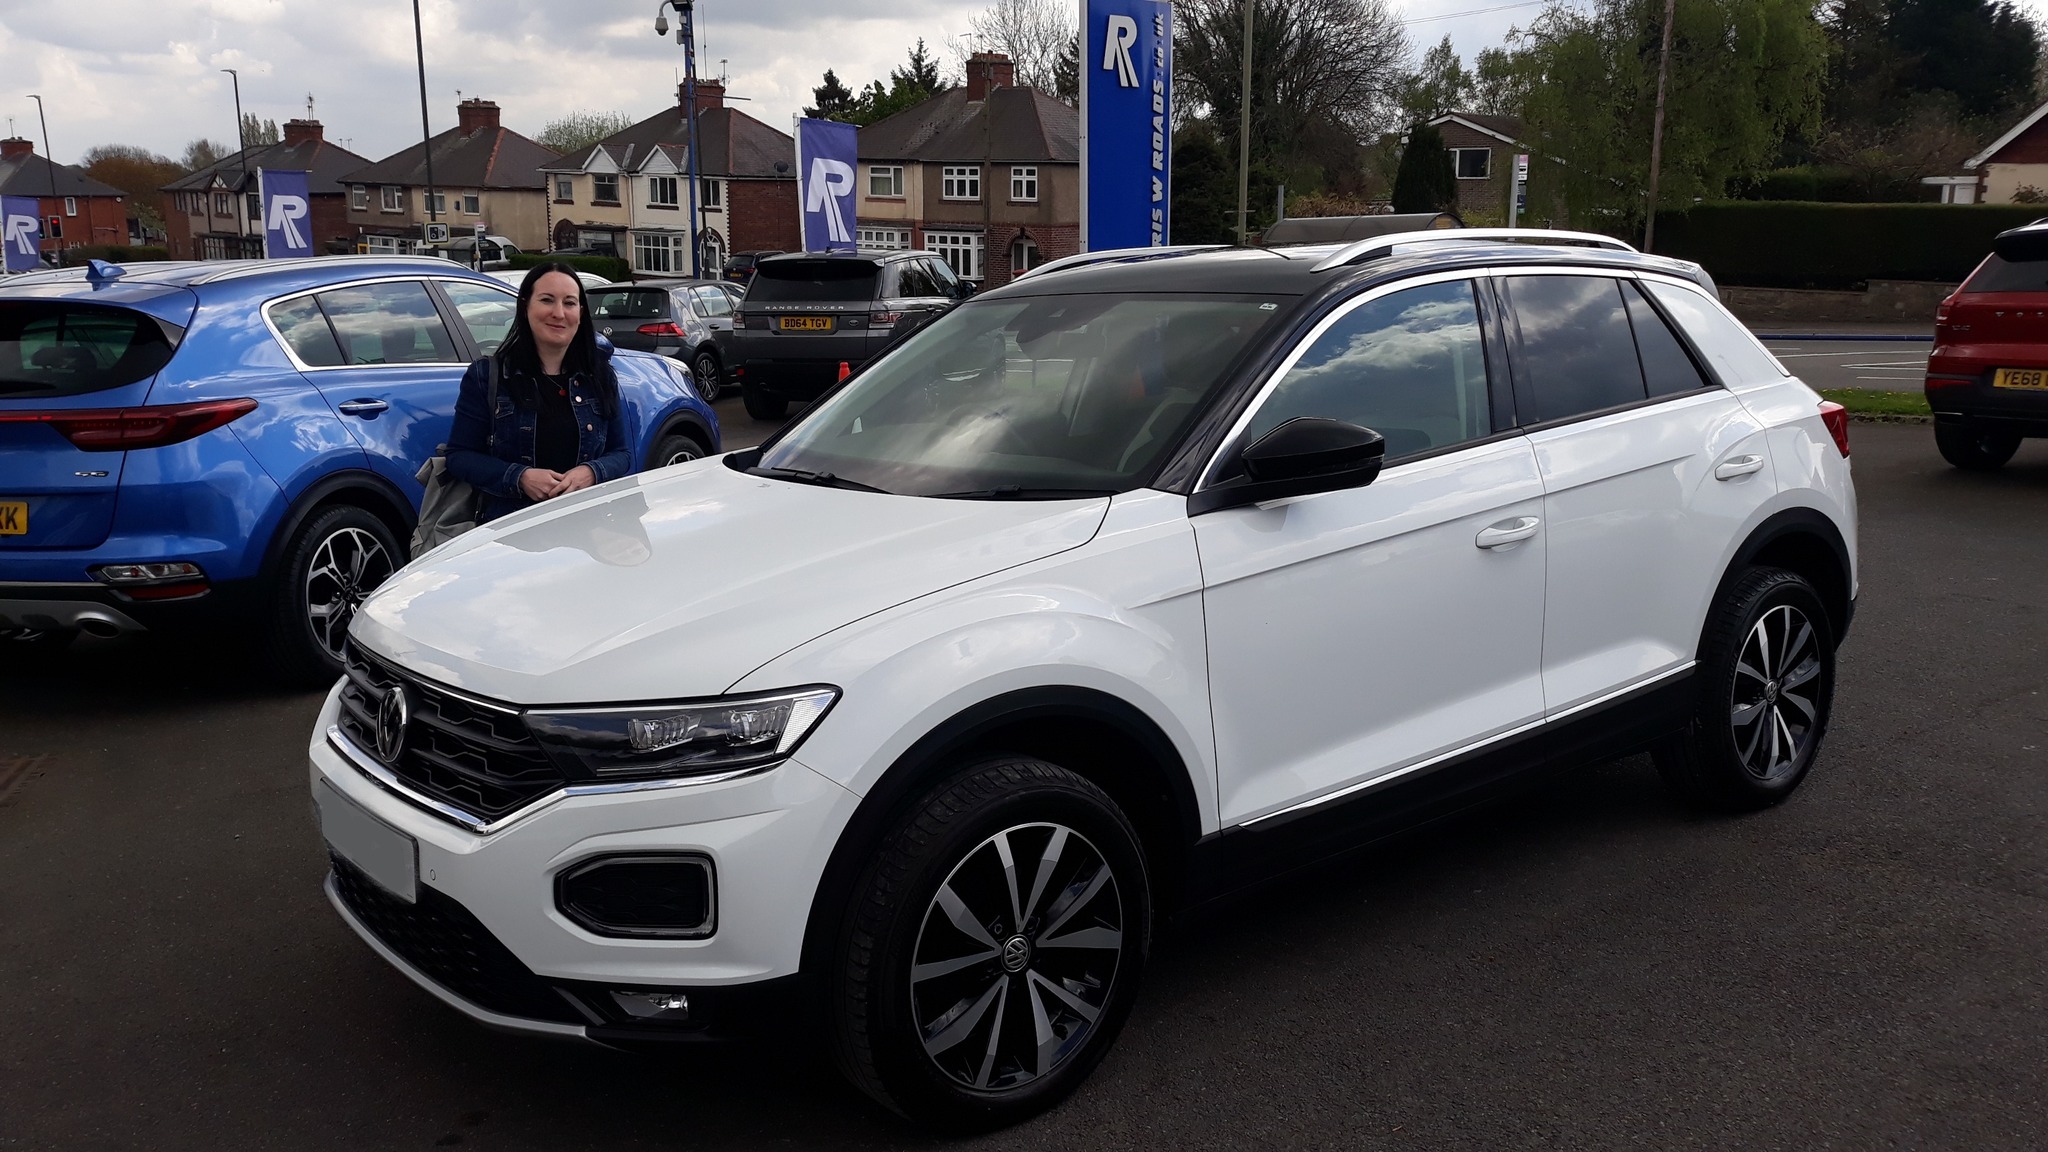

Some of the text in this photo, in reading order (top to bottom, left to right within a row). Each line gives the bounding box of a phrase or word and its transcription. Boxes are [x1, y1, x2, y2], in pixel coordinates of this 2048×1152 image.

[1152, 175, 1163, 202] W
[784, 318, 828, 328] BD64 TGV
[2003, 371, 2042, 386] YE68
